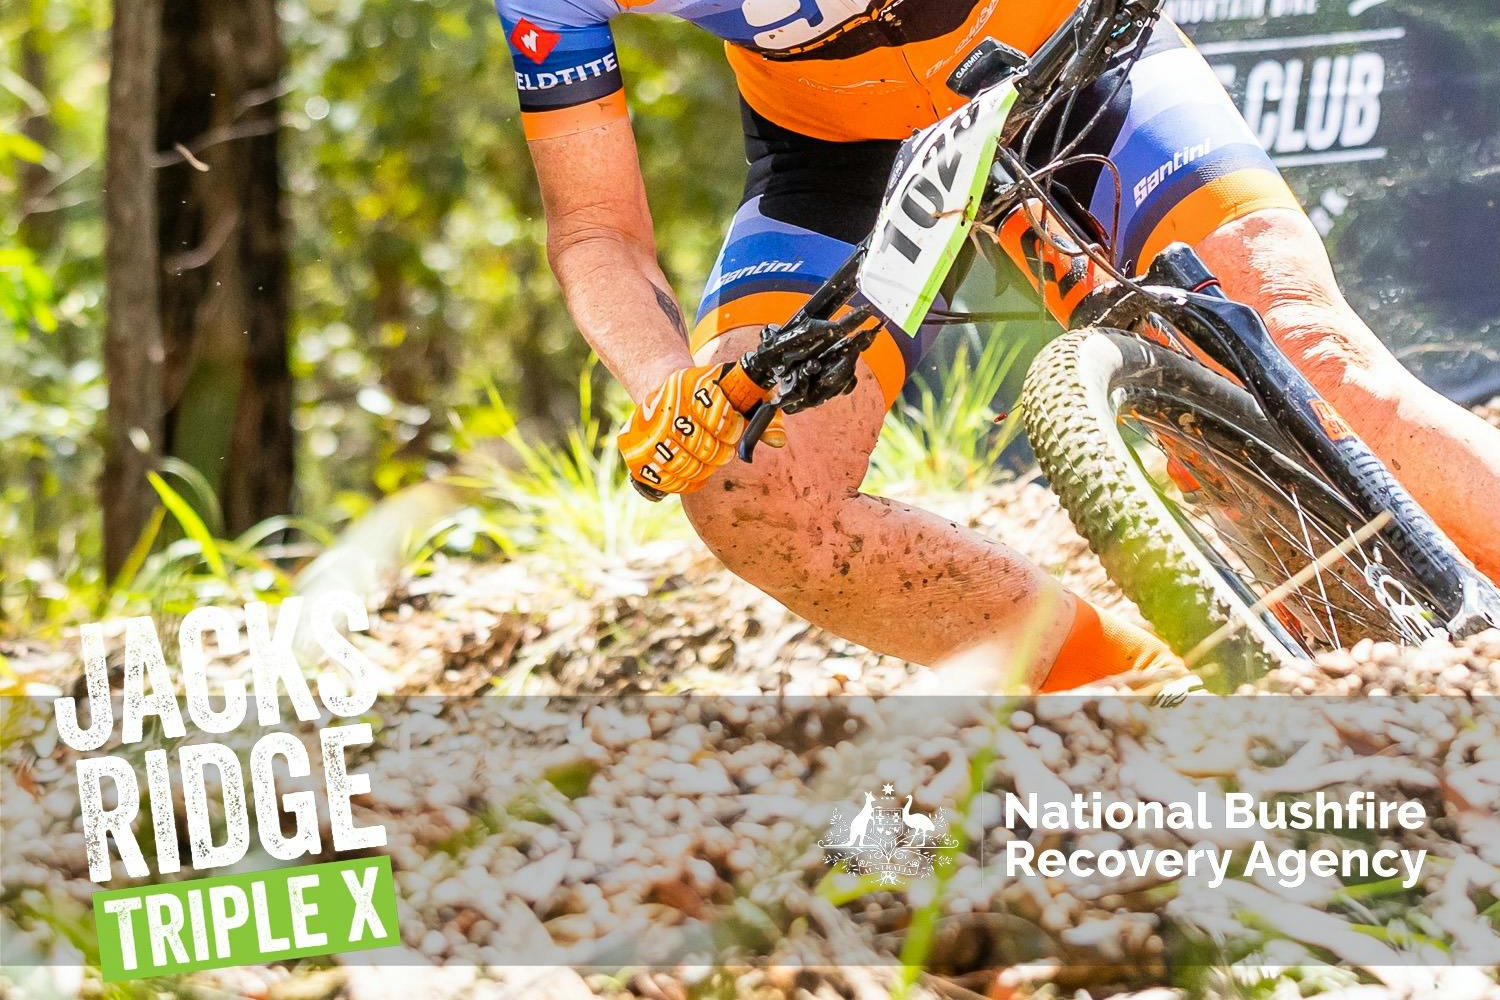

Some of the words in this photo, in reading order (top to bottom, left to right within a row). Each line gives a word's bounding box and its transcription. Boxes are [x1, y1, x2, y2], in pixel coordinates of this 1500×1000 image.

[955, 49, 983, 79] GARMIN
[1243, 51, 1386, 154] CLUB
[1133, 137, 1211, 208] Santini
[640, 387, 713, 485] FIST
